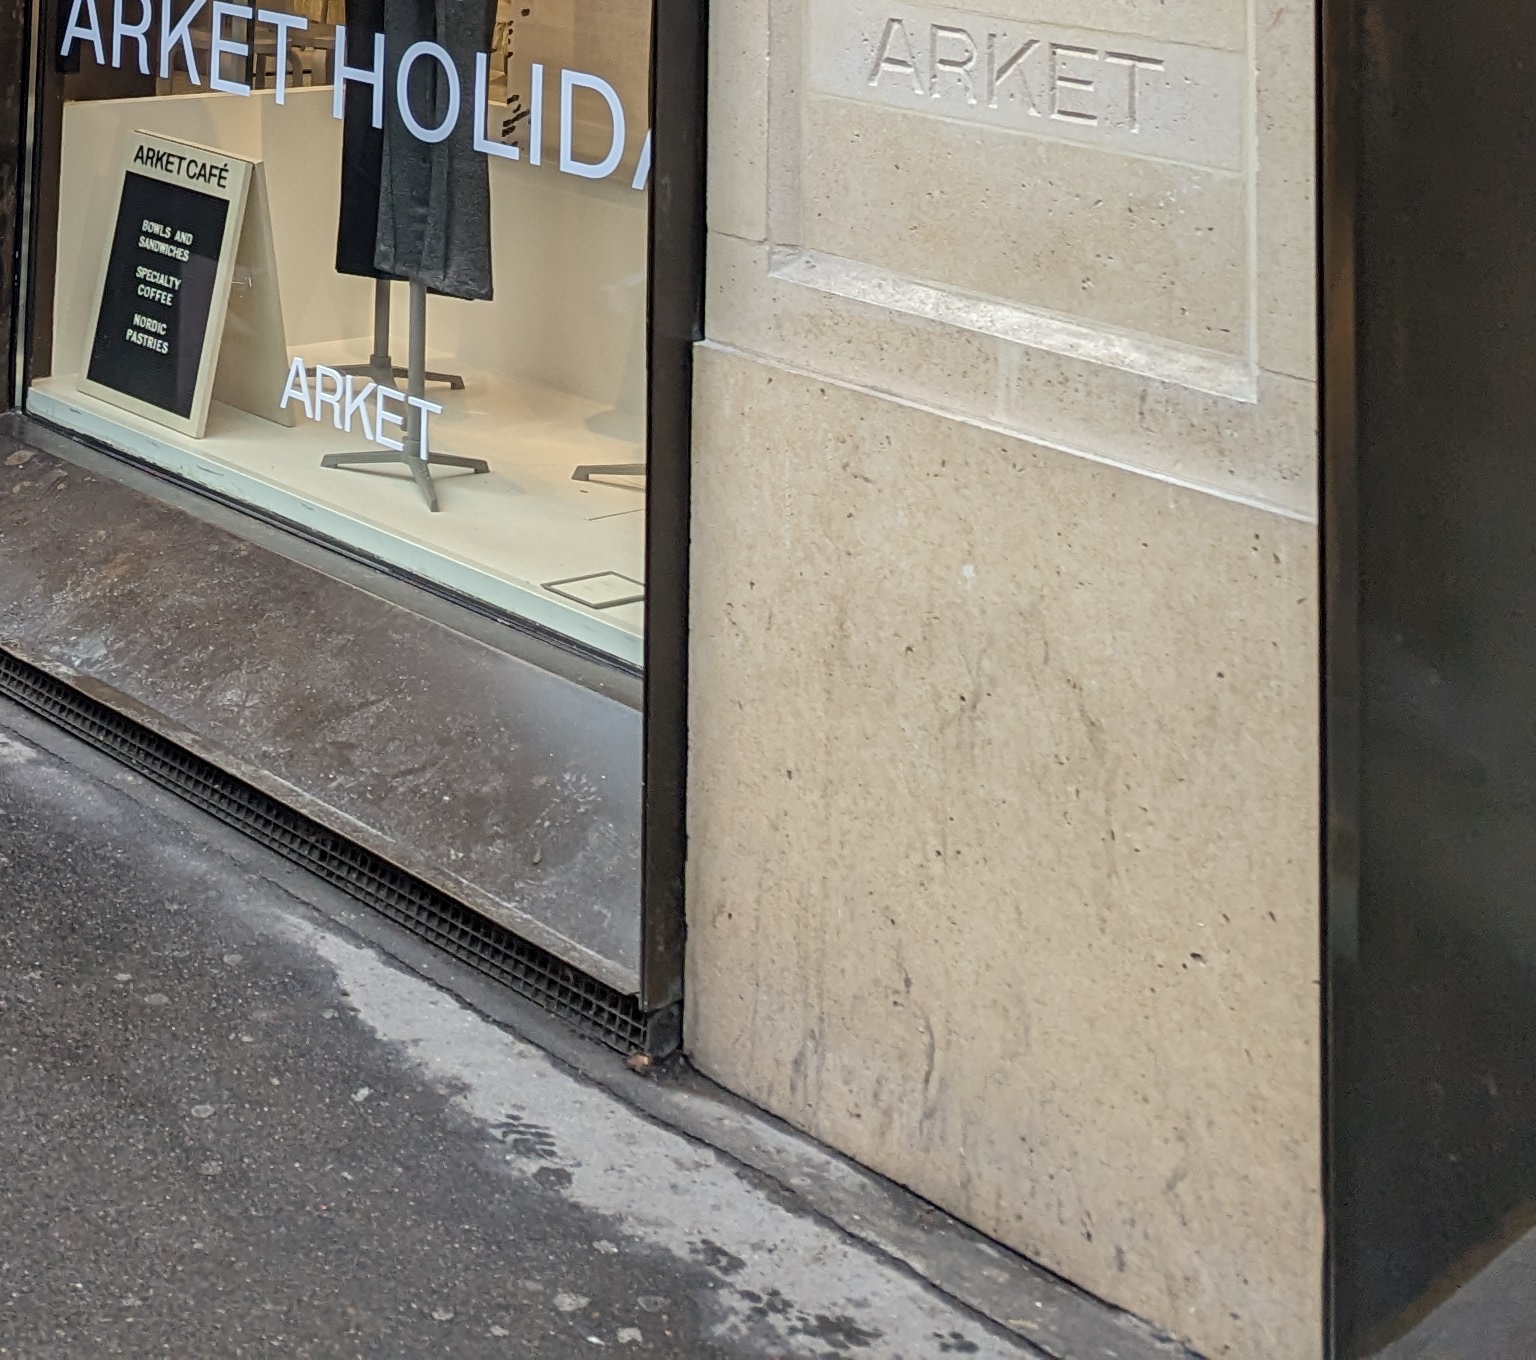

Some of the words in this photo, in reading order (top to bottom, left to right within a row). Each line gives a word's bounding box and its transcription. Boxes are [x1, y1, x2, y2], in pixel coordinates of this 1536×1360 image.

[868, 17, 1165, 134] ARKET
[133, 144, 187, 177] ARKET
[186, 160, 230, 189] CAFÉ
[141, 219, 172, 240] BOWLS
[173, 229, 194, 246] AND
[138, 235, 190, 263] SANDWICHES
[135, 265, 182, 292] SPECIALTY
[137, 283, 174, 307] COFFEE
[133, 313, 167, 336] NORDIC
[125, 329, 170, 355] PASTRIES
[279, 356, 444, 461] ARKET
